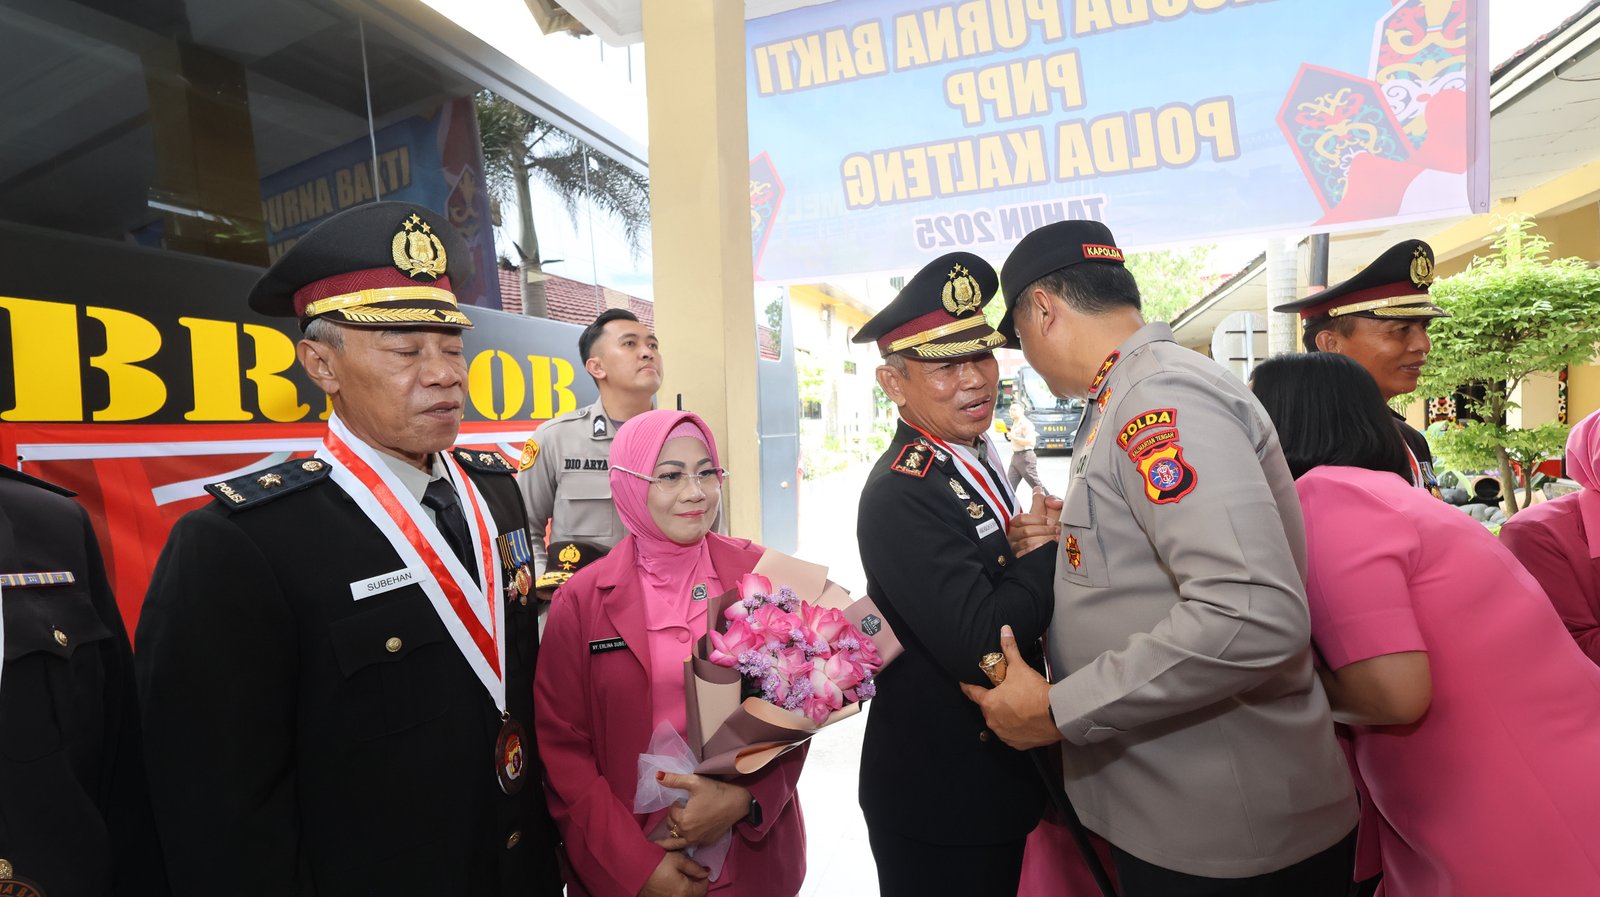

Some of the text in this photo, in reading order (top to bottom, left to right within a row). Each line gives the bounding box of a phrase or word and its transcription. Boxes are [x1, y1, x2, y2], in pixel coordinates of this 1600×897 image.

[1086, 246, 1122, 259] KAPOLDA
[0, 296, 577, 422] BROB
[1121, 411, 1171, 446] POLDA
[564, 458, 609, 471] DIO ARYA
[367, 572, 412, 592] SUBEHAN
